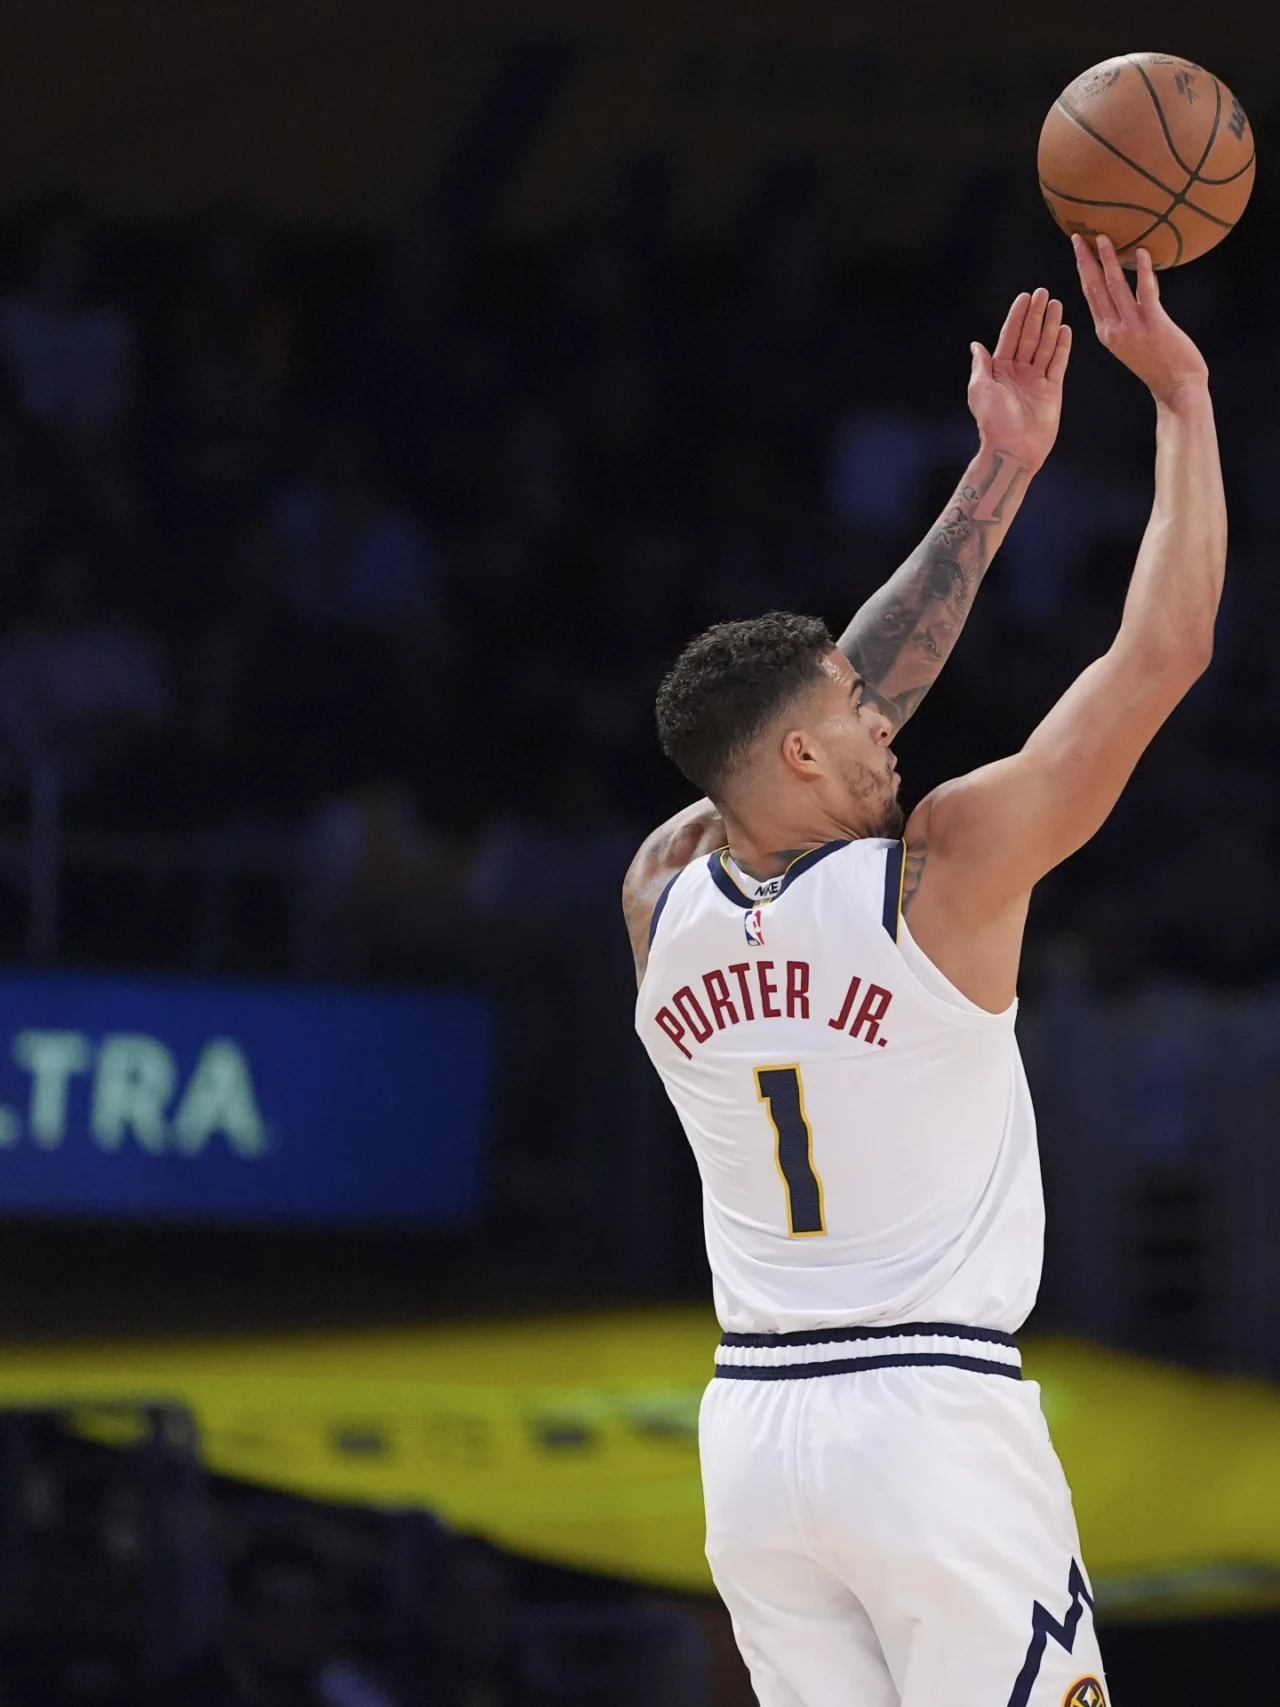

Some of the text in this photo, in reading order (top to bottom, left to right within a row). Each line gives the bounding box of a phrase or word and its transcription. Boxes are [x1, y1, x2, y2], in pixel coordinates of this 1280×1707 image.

[655, 960, 893, 1060] PORTER JR.
[752, 1062, 828, 1239] 1
